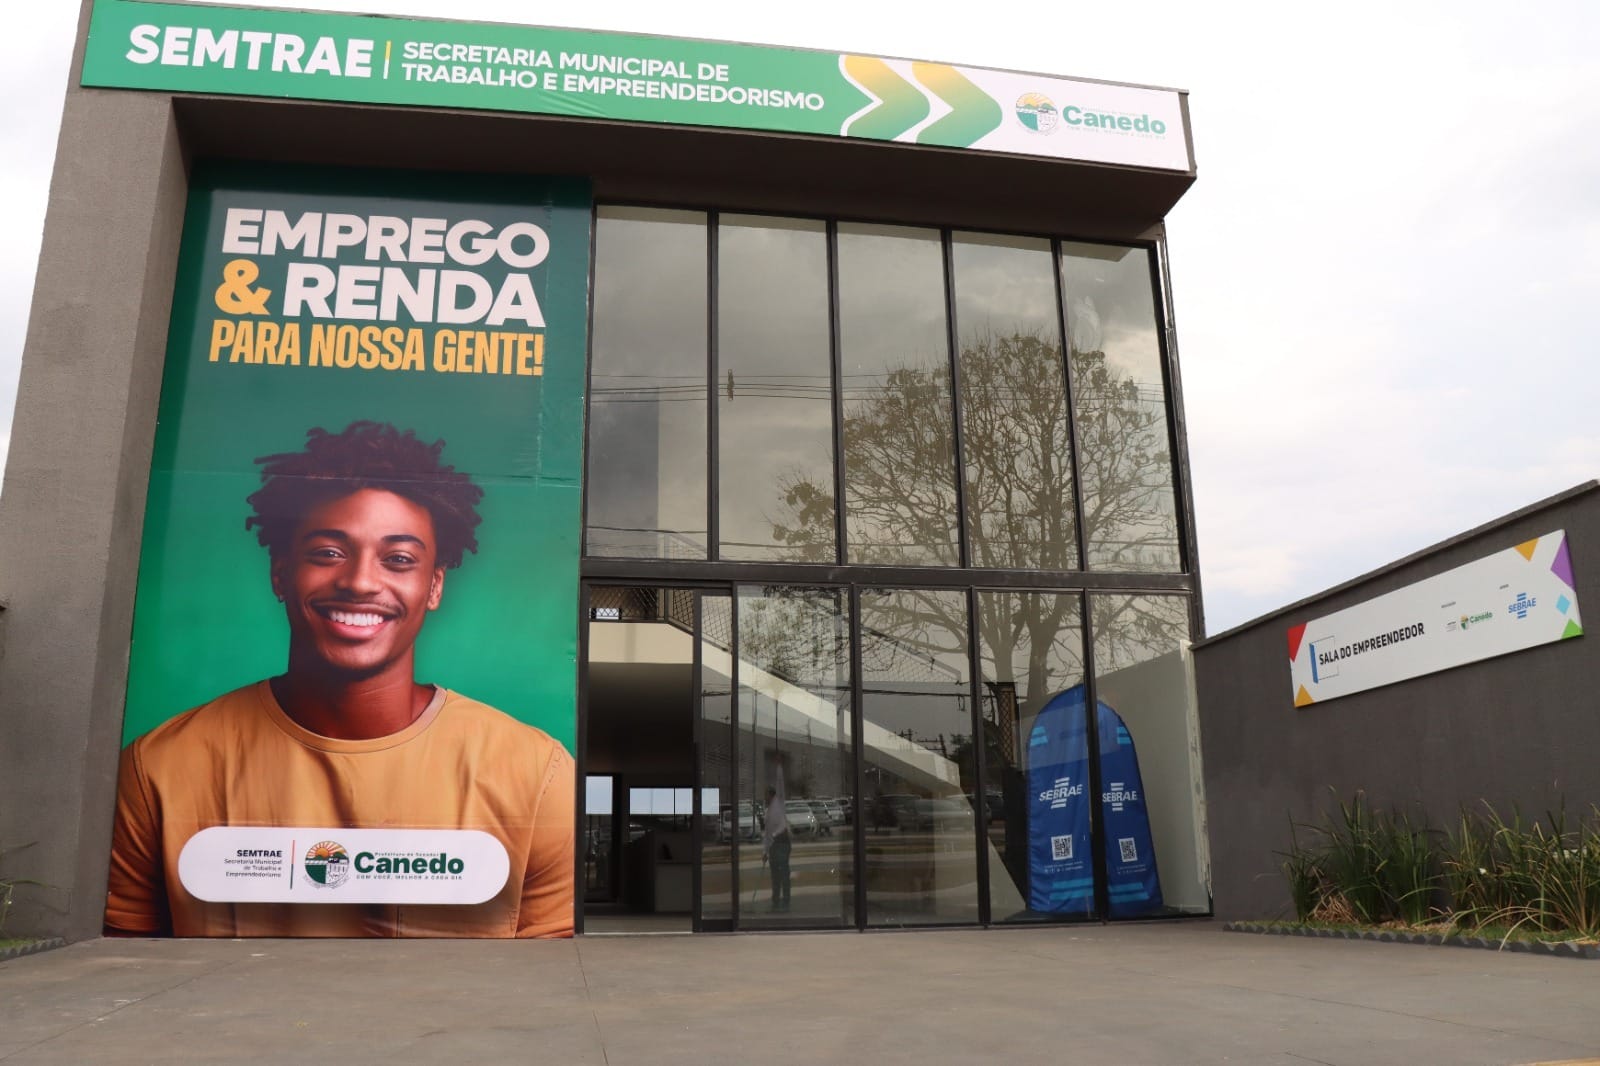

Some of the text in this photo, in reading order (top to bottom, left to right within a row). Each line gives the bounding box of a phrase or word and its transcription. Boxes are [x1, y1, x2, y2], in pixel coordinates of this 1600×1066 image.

[126, 24, 374, 78] SEMTRAE
[403, 41, 729, 82] SECRETARIA MUNICIPAL DE
[402, 63, 824, 111] TRABALHO E EMPREENDEDORISMO
[1062, 105, 1166, 134] Canedo
[222, 208, 550, 269] EMPREGO
[214, 259, 546, 328] & RENDA
[209, 319, 544, 376] PARA NOSSA GENTE!
[1508, 598, 1536, 614] SEBRAE
[1319, 622, 1425, 665] SALA DO EMPREENDEDOR
[1039, 784, 1083, 801] SEBRAE
[1102, 790, 1137, 803] SEBRAE
[237, 849, 282, 857] SEMTRAE
[354, 851, 464, 873] Canedo
